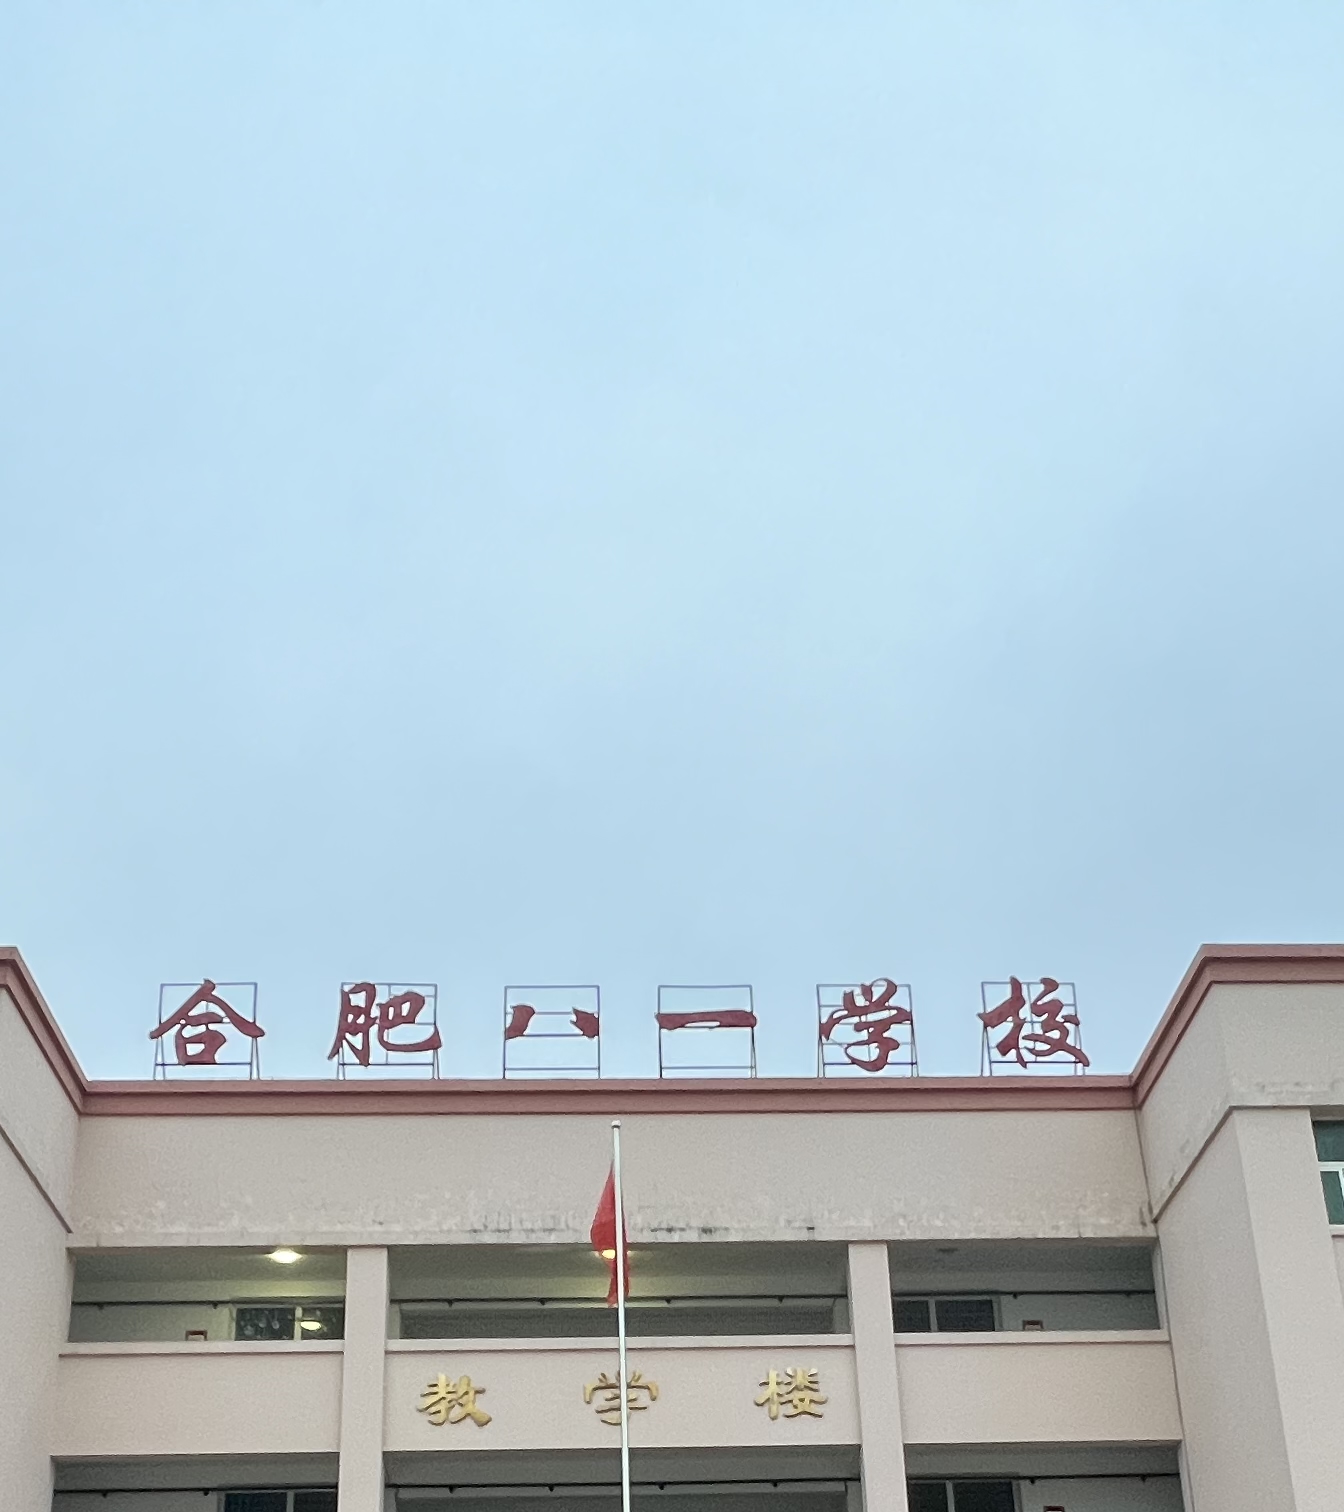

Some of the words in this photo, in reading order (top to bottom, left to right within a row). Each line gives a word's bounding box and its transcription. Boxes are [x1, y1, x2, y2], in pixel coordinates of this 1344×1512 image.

[150, 979, 1090, 1070] 合肥八一学校
[417, 1367, 827, 1426] 教学楼
